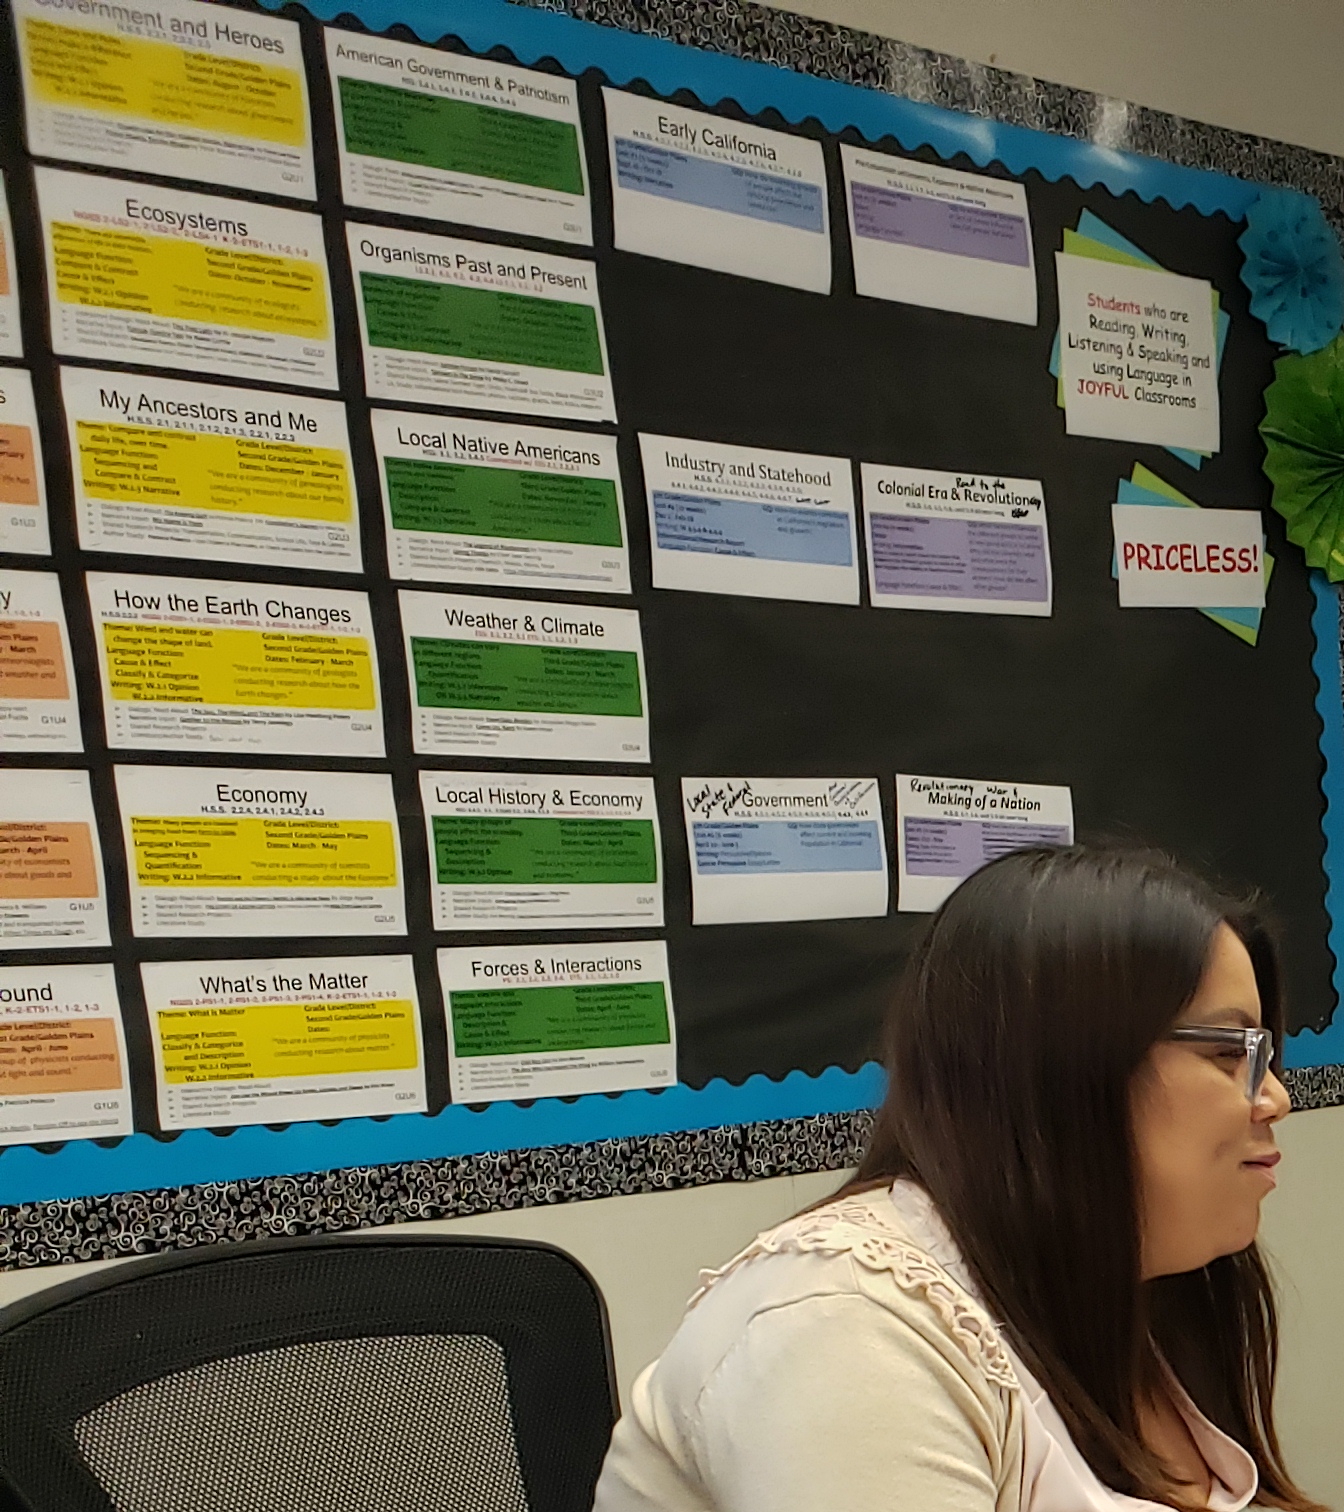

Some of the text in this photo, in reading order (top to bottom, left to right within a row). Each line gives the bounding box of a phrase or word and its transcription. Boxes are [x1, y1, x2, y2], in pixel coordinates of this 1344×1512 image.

[171, 16, 208, 38] and
[215, 22, 284, 54] Heroes
[337, 44, 569, 105] American Government & Patriotism
[658, 116, 777, 161] Early California
[126, 199, 248, 236] Ecosystems
[360, 240, 587, 290] Organisms Past and Present
[1088, 292, 1188, 323] Students who are
[1090, 314, 1189, 347] Reading, Writing,
[1068, 333, 1210, 369] Listening & Speaking and
[1093, 363, 1192, 388] using Language in
[1077, 379, 1196, 408] JOYFUL Classrooms
[100, 389, 317, 433] My Ancestors and Me
[397, 427, 600, 466] Local Native Americans
[665, 452, 831, 487] Industry and Statehood
[878, 480, 924, 497] Colonial
[929, 486, 947, 499] Era
[951, 489, 960, 500] &
[1123, 542, 1258, 573] PRICELESS!
[114, 590, 351, 624] How the Earth Changes
[444, 609, 604, 637] Weather & Climate
[217, 784, 308, 807] Economy
[436, 786, 642, 810] Local History & Economy
[742, 792, 828, 807] Government
[928, 792, 1041, 811] Making of a Nation
[472, 957, 641, 977] Forces & Interactions
[200, 973, 368, 994] What's the Matter
